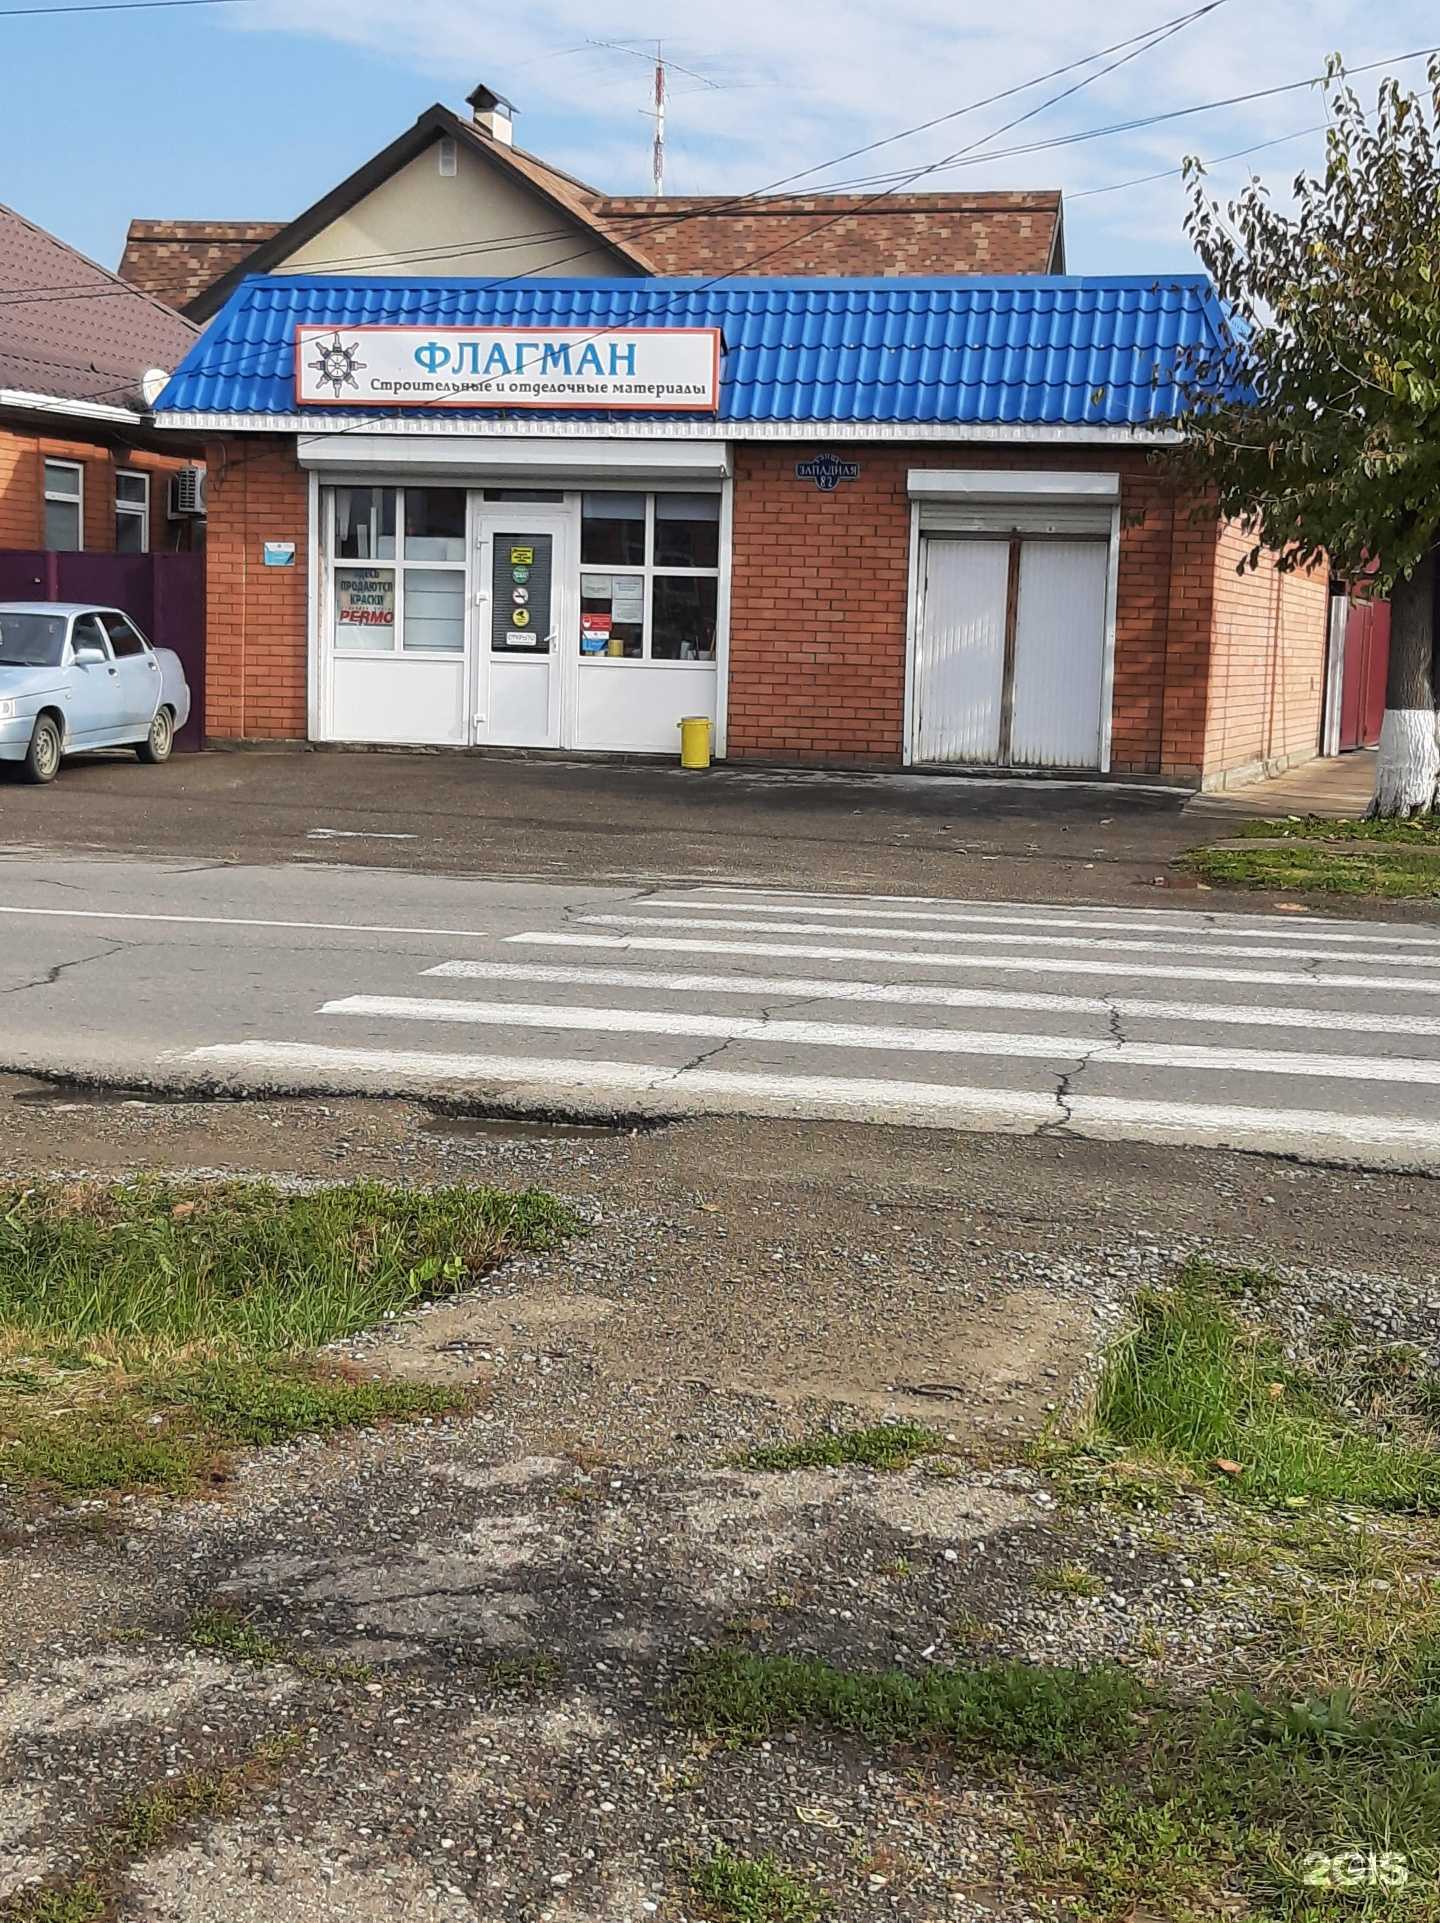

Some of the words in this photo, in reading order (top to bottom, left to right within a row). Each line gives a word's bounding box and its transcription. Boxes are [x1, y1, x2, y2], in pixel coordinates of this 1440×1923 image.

[414, 341, 636, 375] ФЛАГМАН
[370, 379, 492, 394] Строительные
[496, 383, 505, 393] и
[509, 382, 608, 397] отделочные
[612, 384, 706, 398] материалы
[799, 465, 857, 476] ЗАПАДНАЯ
[820, 475, 833, 488] 82
[350, 594, 384, 606] КРАСКИ
[340, 610, 394, 624] PERMO
